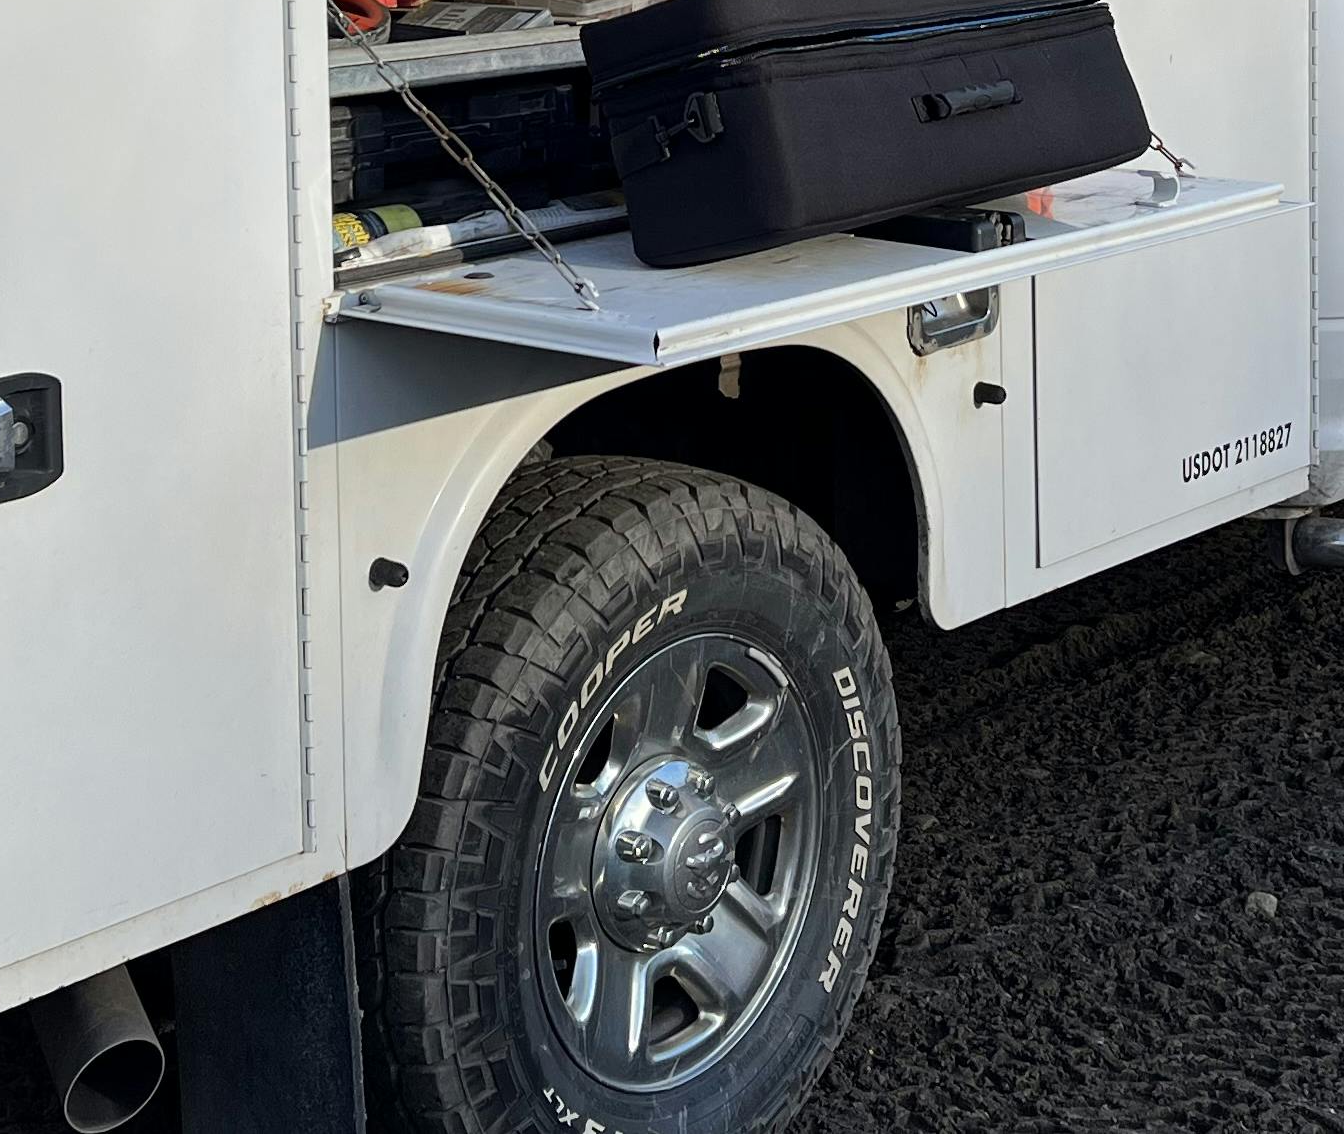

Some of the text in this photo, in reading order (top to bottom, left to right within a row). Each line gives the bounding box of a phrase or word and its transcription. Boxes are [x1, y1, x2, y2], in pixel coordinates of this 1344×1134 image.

[1182, 422, 1292, 483] USDOT 2118827
[539, 588, 688, 793] COOPER
[818, 666, 873, 994] DISCOVERER
[542, 1087, 580, 1127] XLT
